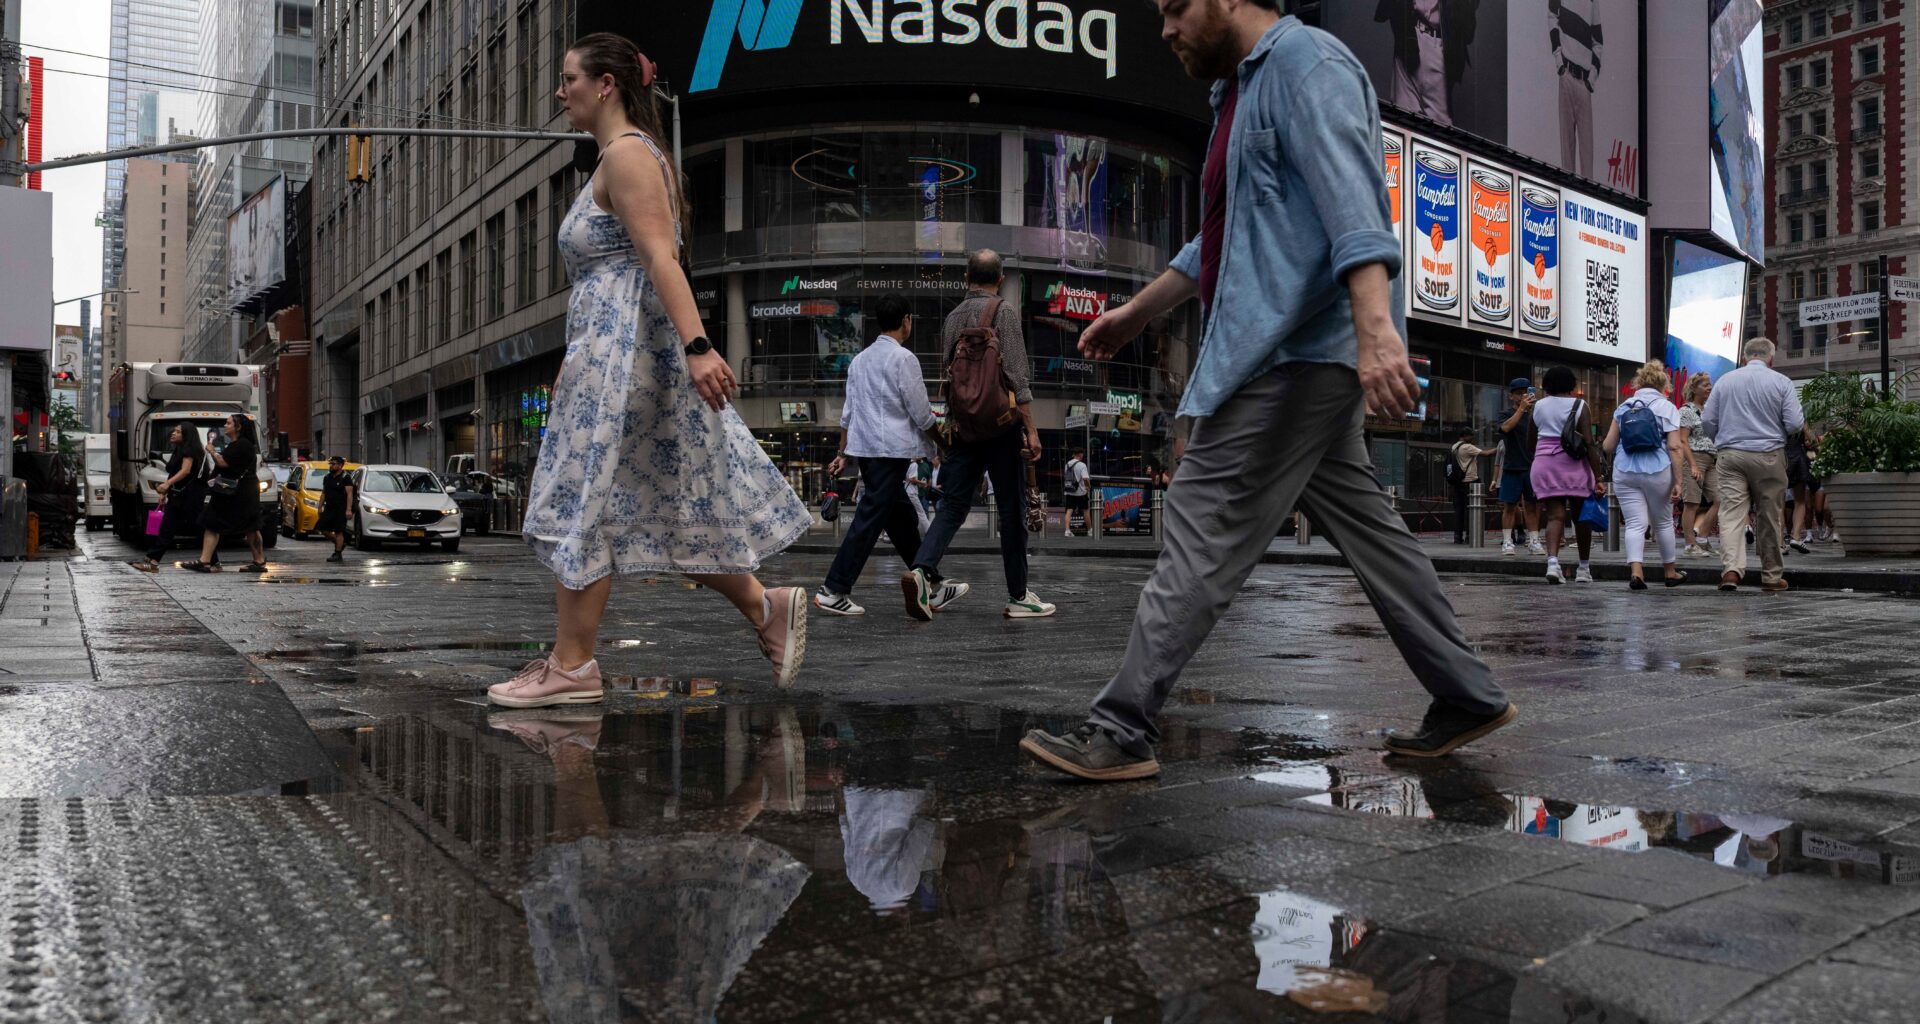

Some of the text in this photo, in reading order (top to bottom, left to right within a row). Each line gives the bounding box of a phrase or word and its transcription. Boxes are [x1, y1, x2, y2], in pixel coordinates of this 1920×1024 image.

[830, 0, 1117, 79] Nasdaq
[1608, 139, 1637, 194] H&M
[1424, 210, 1449, 222] CONDENSED
[1565, 199, 1638, 241] NEW YORK STATE OF MIND
[1421, 255, 1453, 276] NEW YORK
[799, 279, 838, 291] Nasdaq
[856, 280, 969, 290] REWRITE TOMORROW
[1424, 277, 1450, 298] SOUP
[1476, 269, 1505, 289] NEW YORK
[1893, 279, 1919, 289] PEDESTRIAN
[1063, 285, 1097, 300] Nasdaq
[1526, 283, 1553, 299] NEW YORK
[1479, 290, 1503, 310] SOUP
[1805, 296, 1877, 313] PEDESTRIAN FLOW ZONE
[1528, 302, 1550, 321] SOUP
[1836, 306, 1878, 319] KEEP MOVING
[1063, 360, 1093, 374] Nasdaq
